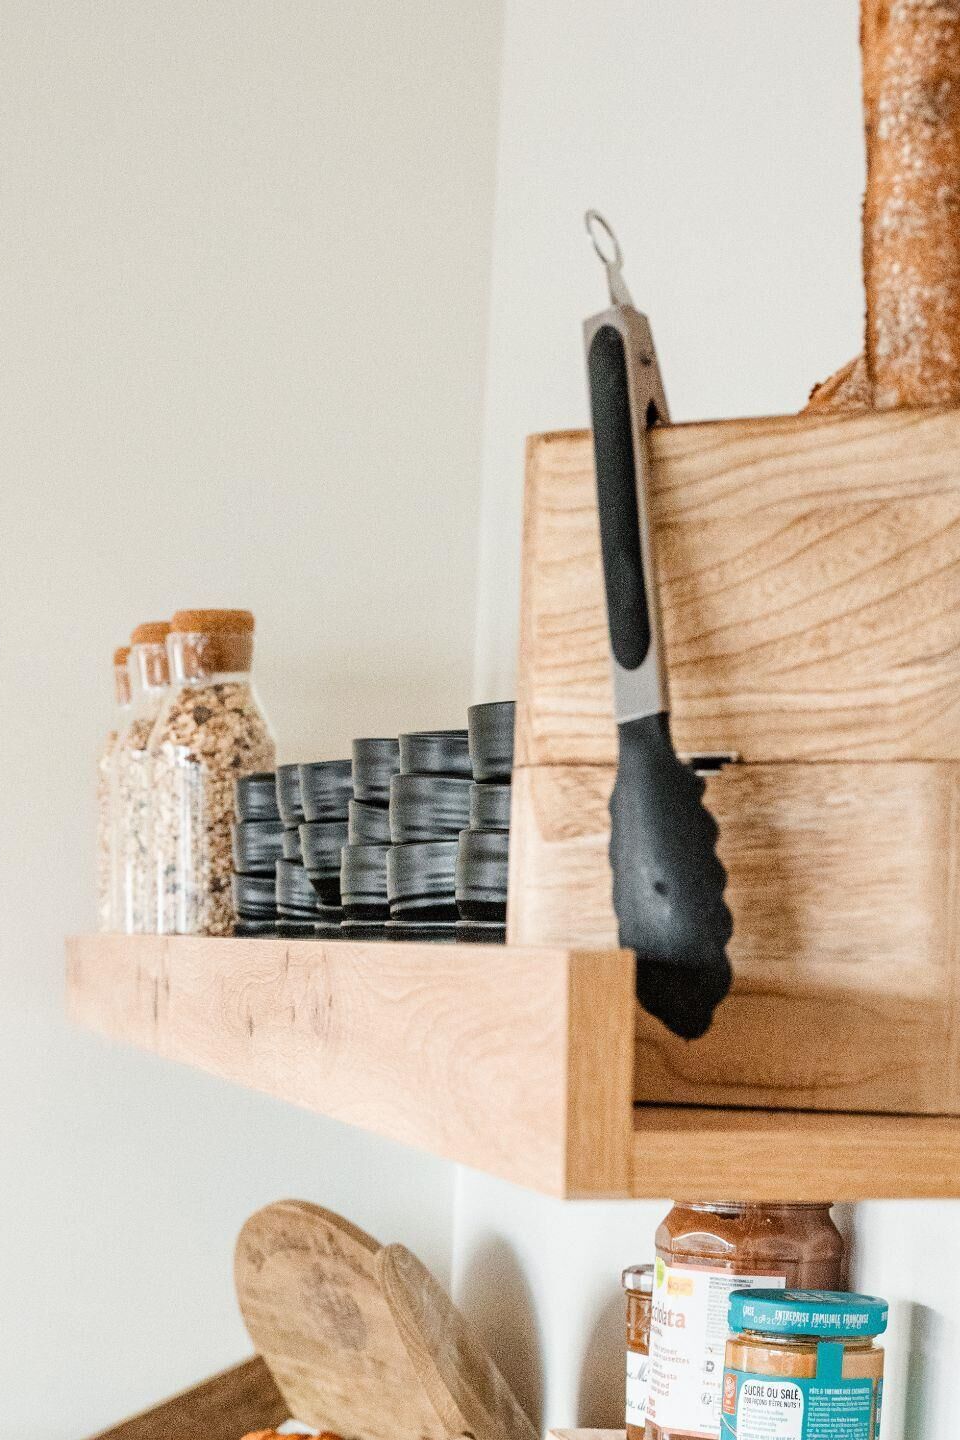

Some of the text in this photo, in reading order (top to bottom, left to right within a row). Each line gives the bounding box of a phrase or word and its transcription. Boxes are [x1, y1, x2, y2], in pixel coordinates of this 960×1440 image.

[775, 1309, 810, 1323] ENTREPRISE
[812, 1312, 841, 1324] FAMILIALE
[767, 1388, 778, 1399] OU
